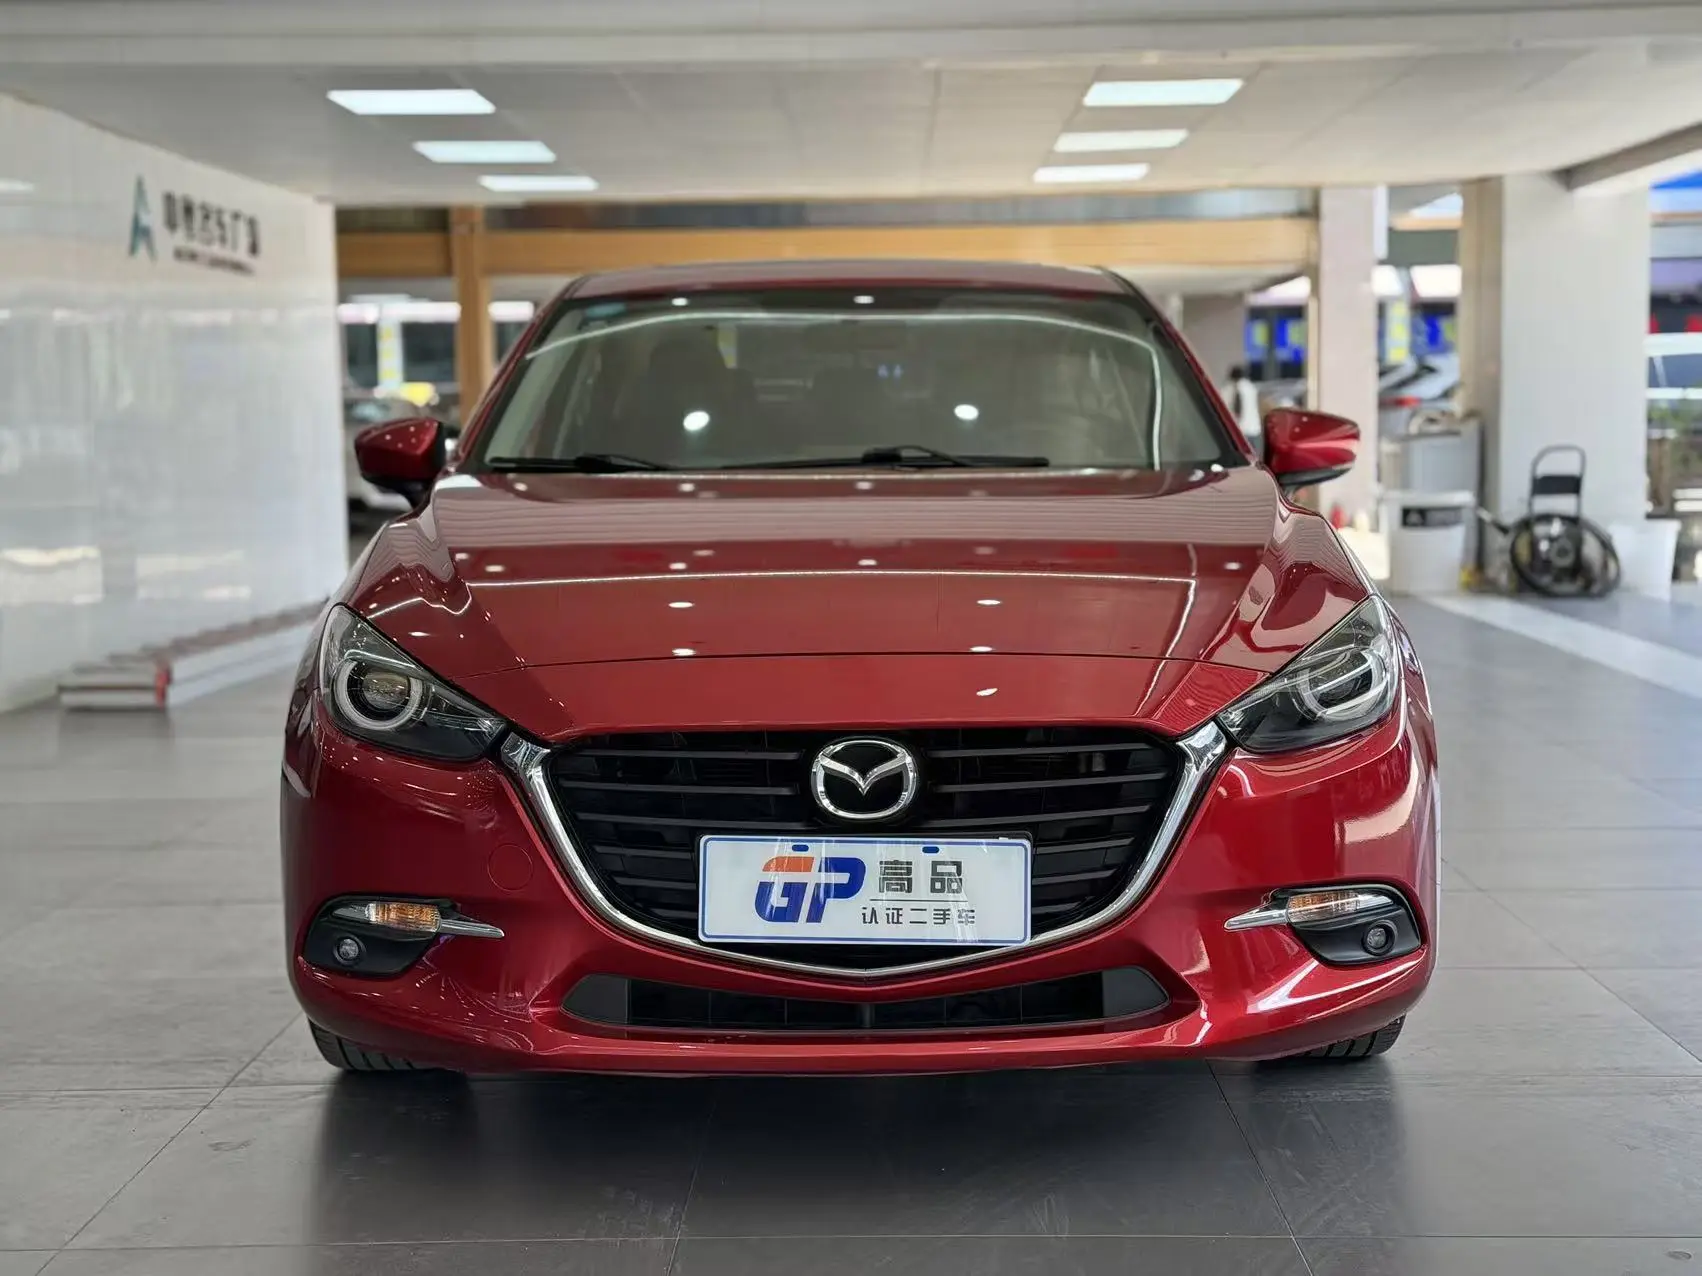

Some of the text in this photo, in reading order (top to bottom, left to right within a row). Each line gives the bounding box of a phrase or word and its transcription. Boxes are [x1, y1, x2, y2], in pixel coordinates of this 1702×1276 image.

[755, 856, 866, 923] GP
[879, 860, 963, 893] 高品
[861, 906, 976, 925] 认证二手车
